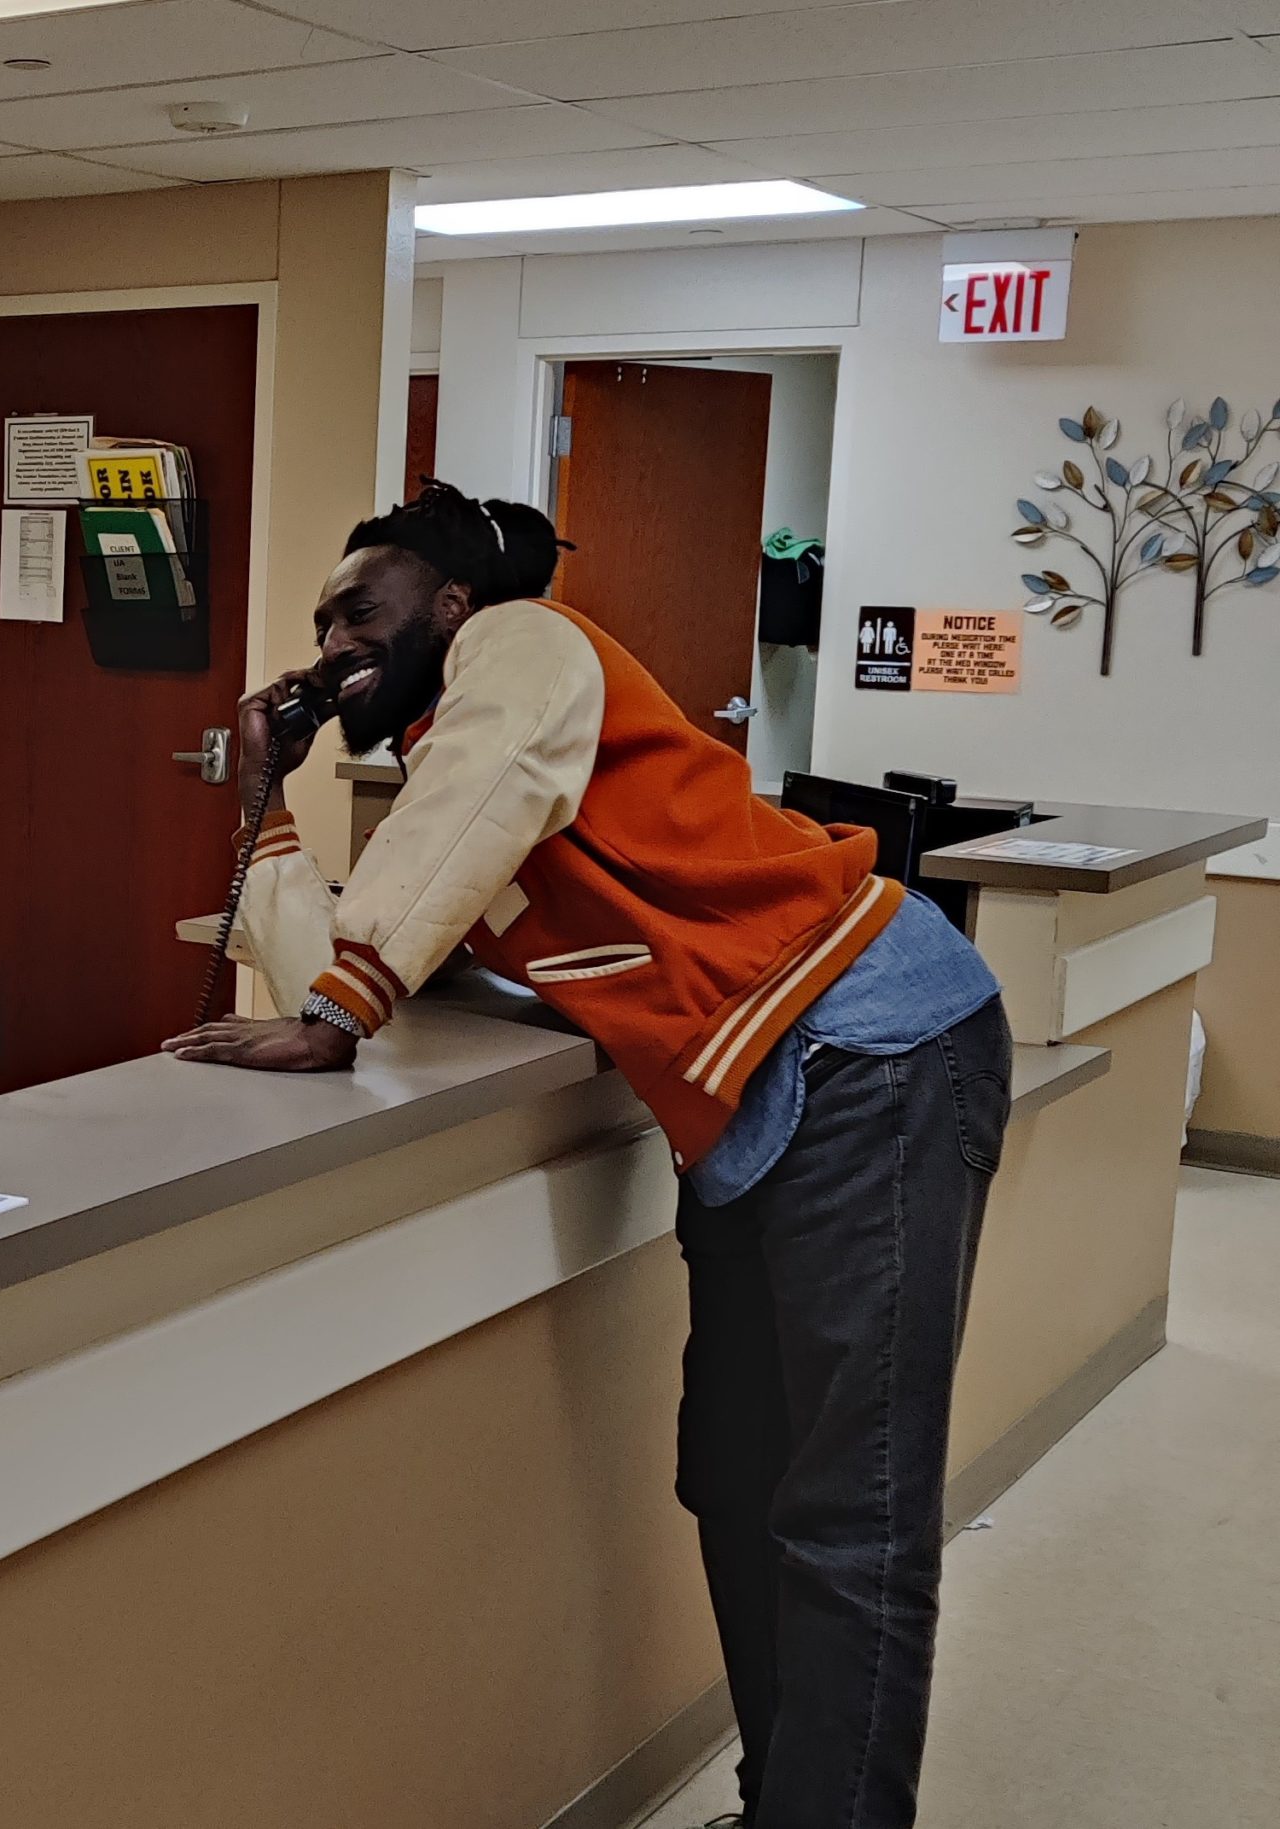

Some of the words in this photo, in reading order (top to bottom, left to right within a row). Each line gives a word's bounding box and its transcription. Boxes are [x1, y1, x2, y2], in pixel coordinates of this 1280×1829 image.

[964, 270, 1050, 333] EXIT
[96, 467, 112, 499] OR
[117, 573, 137, 581] Blank
[943, 615, 996, 631] NOTICE
[921, 632, 949, 641] DURING
[951, 633, 996, 642] MEDICATION
[998, 635, 1016, 643] TIME
[932, 641, 959, 649] PLEASE
[962, 642, 981, 650] WAIT
[940, 650, 955, 658] ONE
[977, 651, 994, 659] TIME
[927, 658, 936, 666] AT
[939, 658, 953, 666] THE
[955, 659, 971, 667] MED
[973, 660, 1006, 668] WINDOW
[867, 667, 900, 675] UNISEX
[918, 666, 943, 674] PLEASE
[977, 668, 986, 676] BE
[988, 669, 1015, 677] CALLED
[860, 674, 907, 684] RESTROOM
[943, 675, 968, 684] THANK
